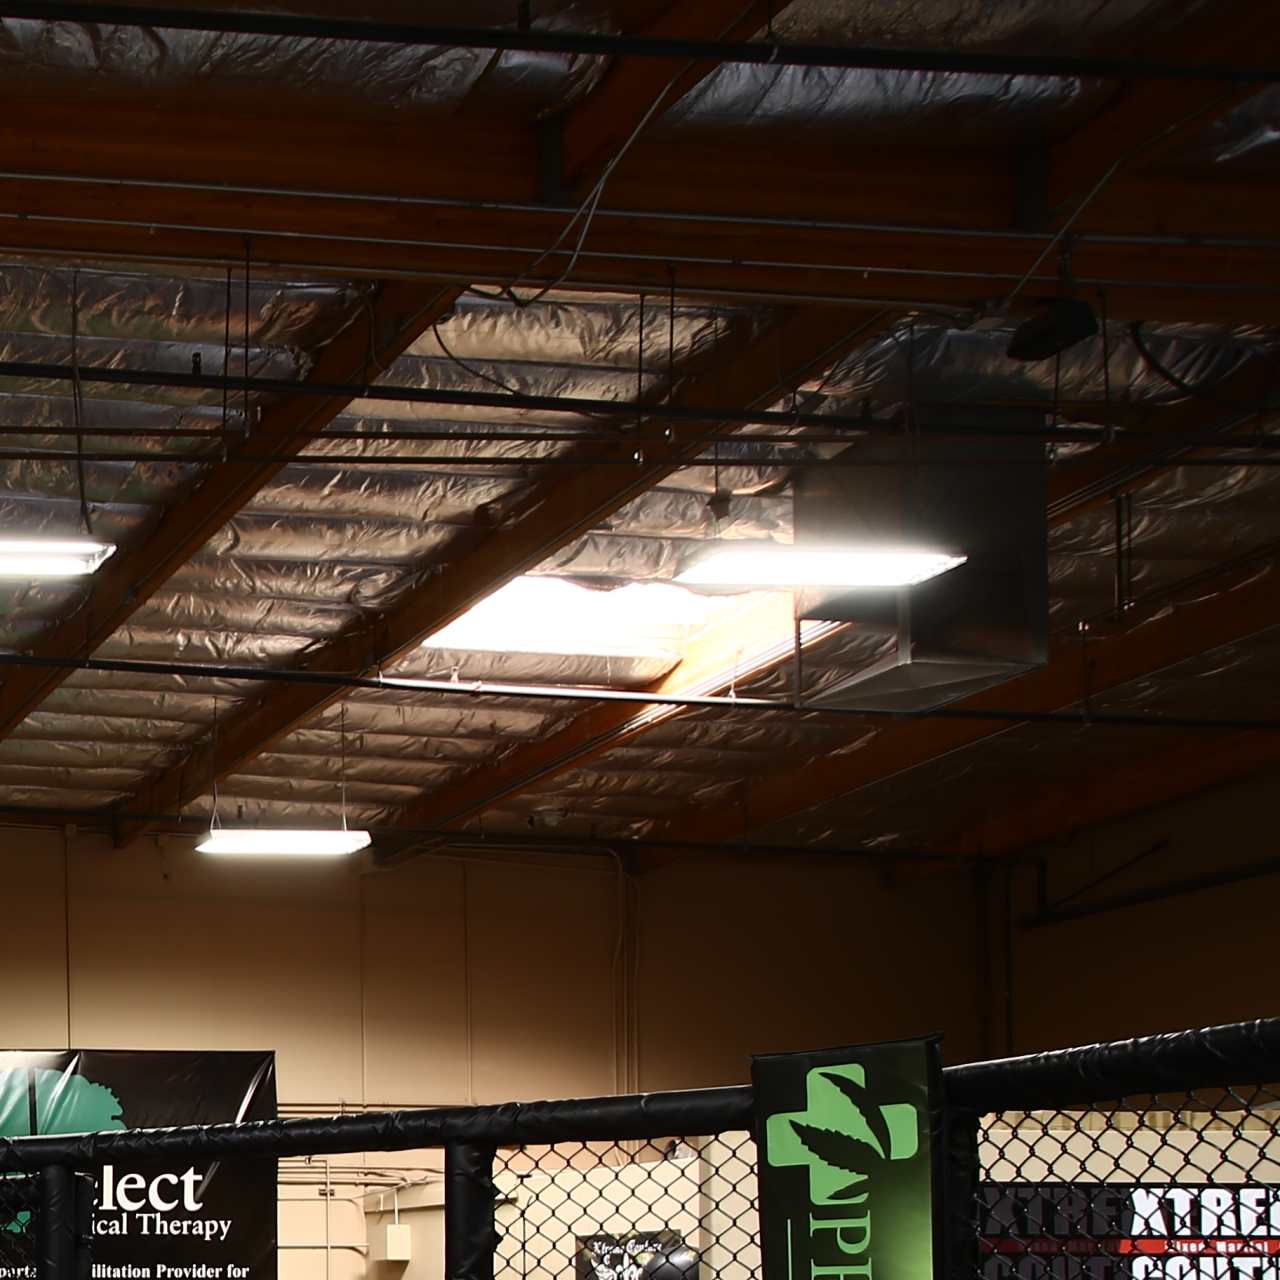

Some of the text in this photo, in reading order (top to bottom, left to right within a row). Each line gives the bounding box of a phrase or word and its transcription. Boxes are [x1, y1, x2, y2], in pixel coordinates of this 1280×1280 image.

[91, 1165, 203, 1211] lect
[136, 1213, 232, 1240] Therapy
[1130, 1188, 1280, 1236] XTRE
[91, 1263, 150, 1279] ilitation
[156, 1263, 223, 1279] Provider
[226, 1263, 250, 1279] for
